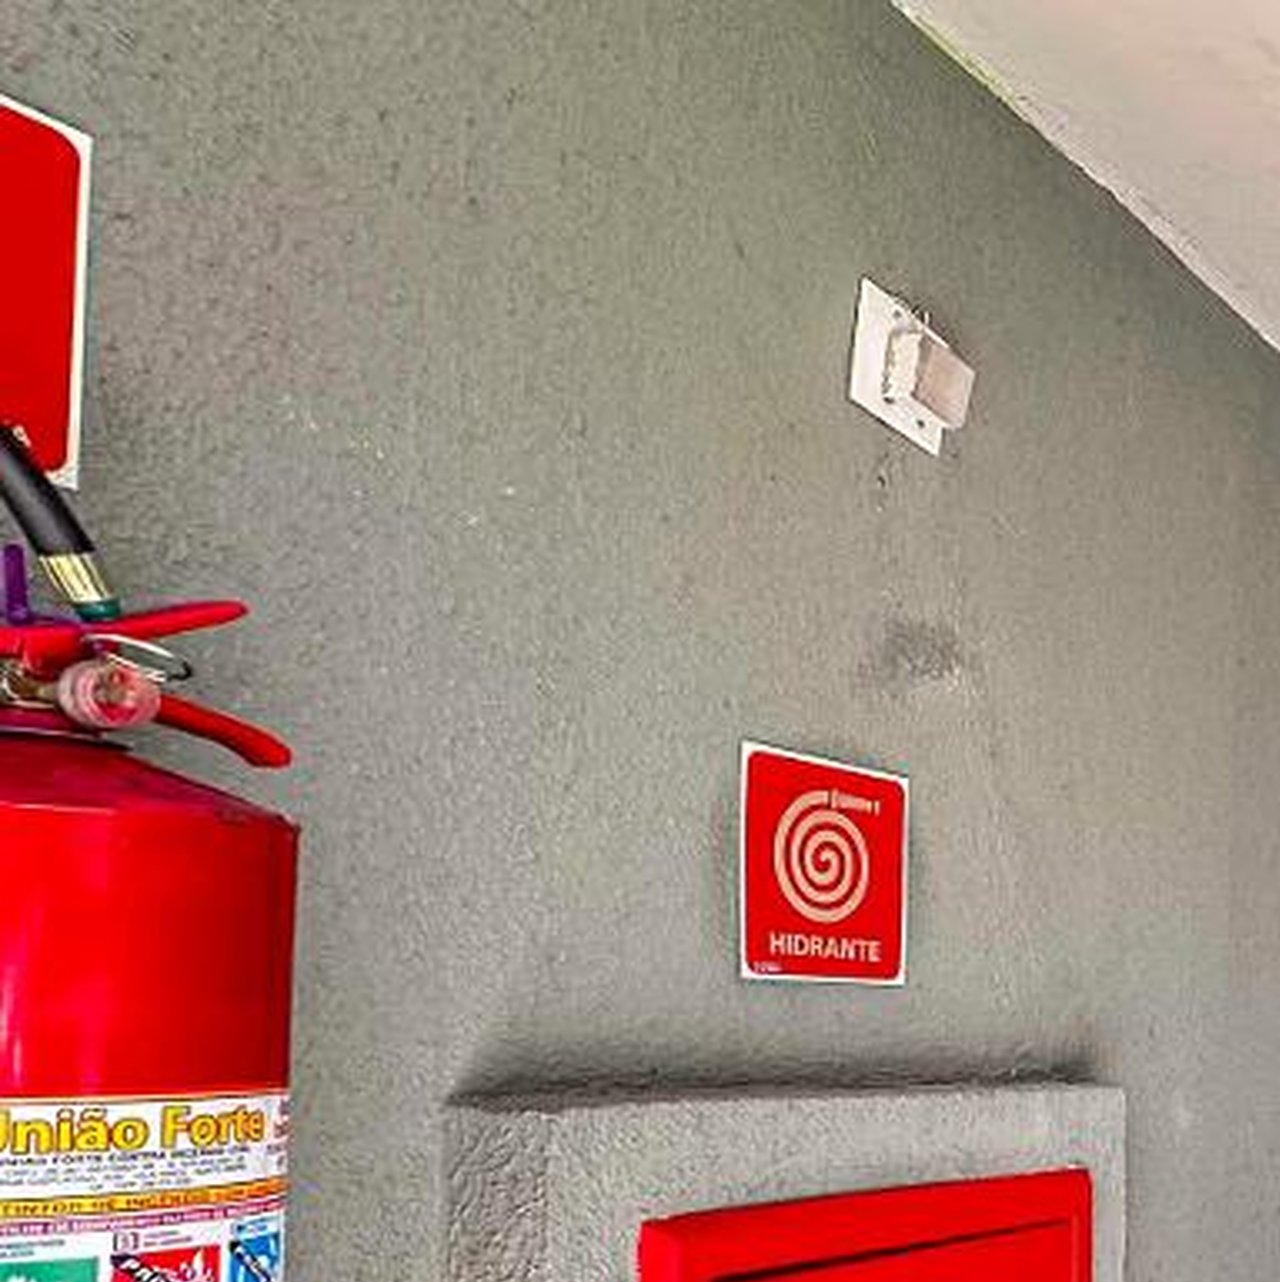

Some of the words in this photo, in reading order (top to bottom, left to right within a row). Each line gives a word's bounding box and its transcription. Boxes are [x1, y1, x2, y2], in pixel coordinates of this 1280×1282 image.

[769, 931, 881, 962] HIDRANTE
[0, 1107, 149, 1156] nião
[160, 1104, 265, 1149] Forte
